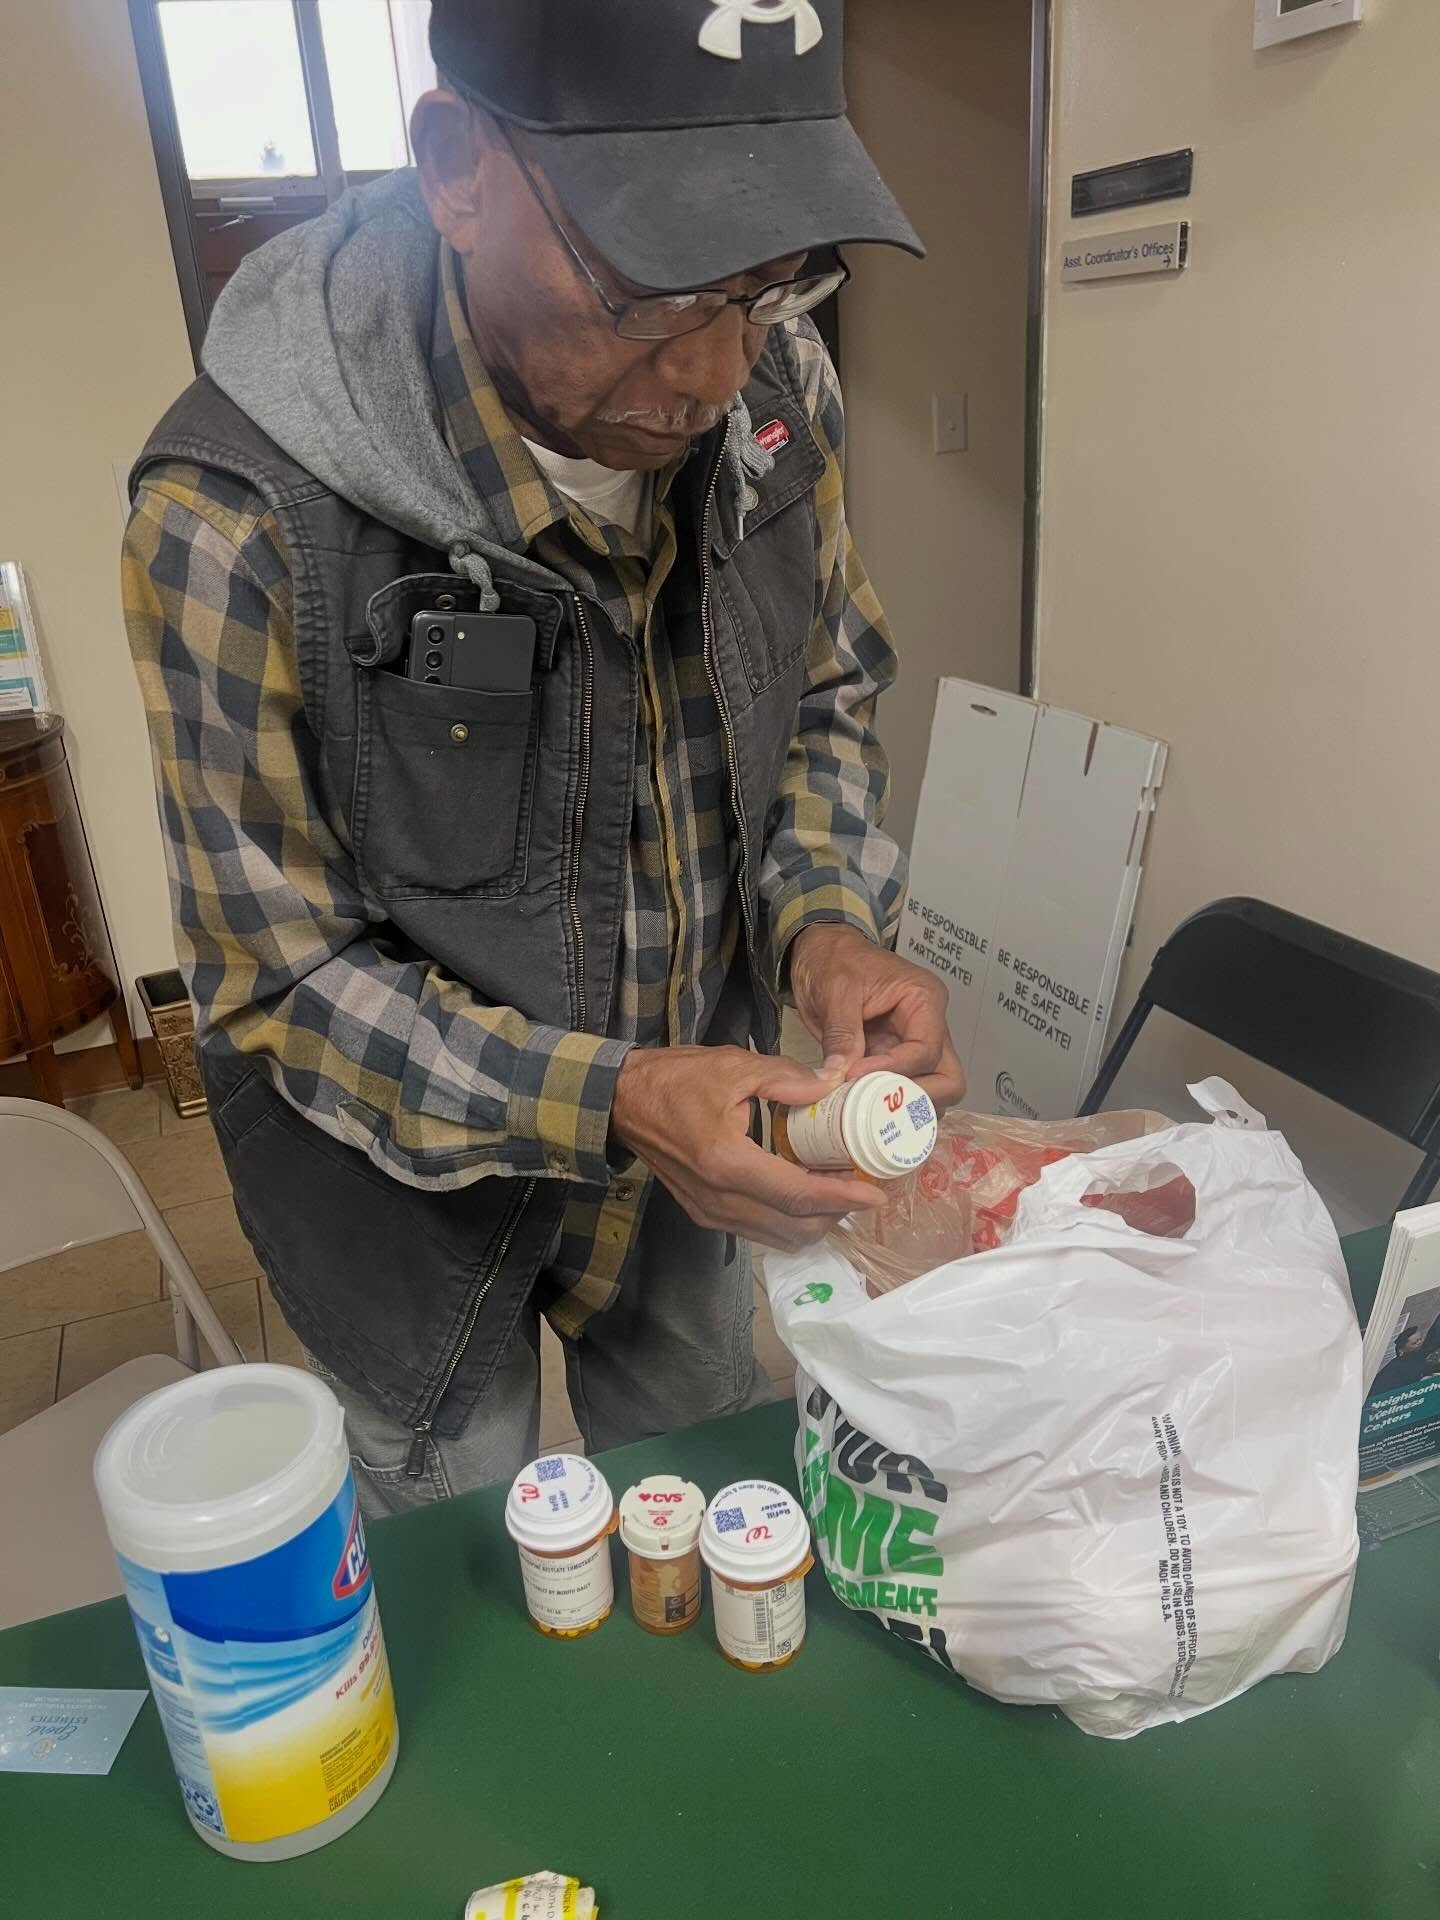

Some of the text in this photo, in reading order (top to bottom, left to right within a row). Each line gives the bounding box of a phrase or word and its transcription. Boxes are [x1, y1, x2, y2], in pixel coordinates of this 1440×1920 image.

[1084, 247, 1138, 266] Coordinator's
[1142, 242, 1175, 257] Offices
[908, 899, 988, 954] BE RESPONSIBLE
[923, 927, 963, 960] BE SAFE
[909, 938, 973, 985] PARTICIPATE!
[998, 949, 1090, 1015] BE RESPONSIBLE
[1015, 981, 1060, 1021] BE SAFE
[998, 992, 1071, 1051] PARTICIPATE!
[880, 1120, 896, 1136] Refill
[884, 1130, 901, 1146] easier
[1172, 1478, 1181, 1487] IS
[653, 1493, 683, 1503] CVS
[1160, 1484, 1169, 1500] AND
[1172, 1487, 1183, 1503] NOT
[761, 1500, 788, 1512] easier
[766, 1508, 791, 1519] Refill
[1180, 1534, 1190, 1545] TO
[1169, 1549, 1179, 1560] DO
[1182, 1547, 1192, 1572] AVOID
[1159, 1560, 1169, 1583] MADE
[1171, 1563, 1180, 1579] NOT
[1161, 1585, 1171, 1594] IN
[1173, 1582, 1182, 1596] USE
[1183, 1573, 1194, 1606] DANGER
[1173, 1597, 1182, 1607] IN
[1186, 1608, 1195, 1620] OF
[336, 1675, 357, 1699] Kills
